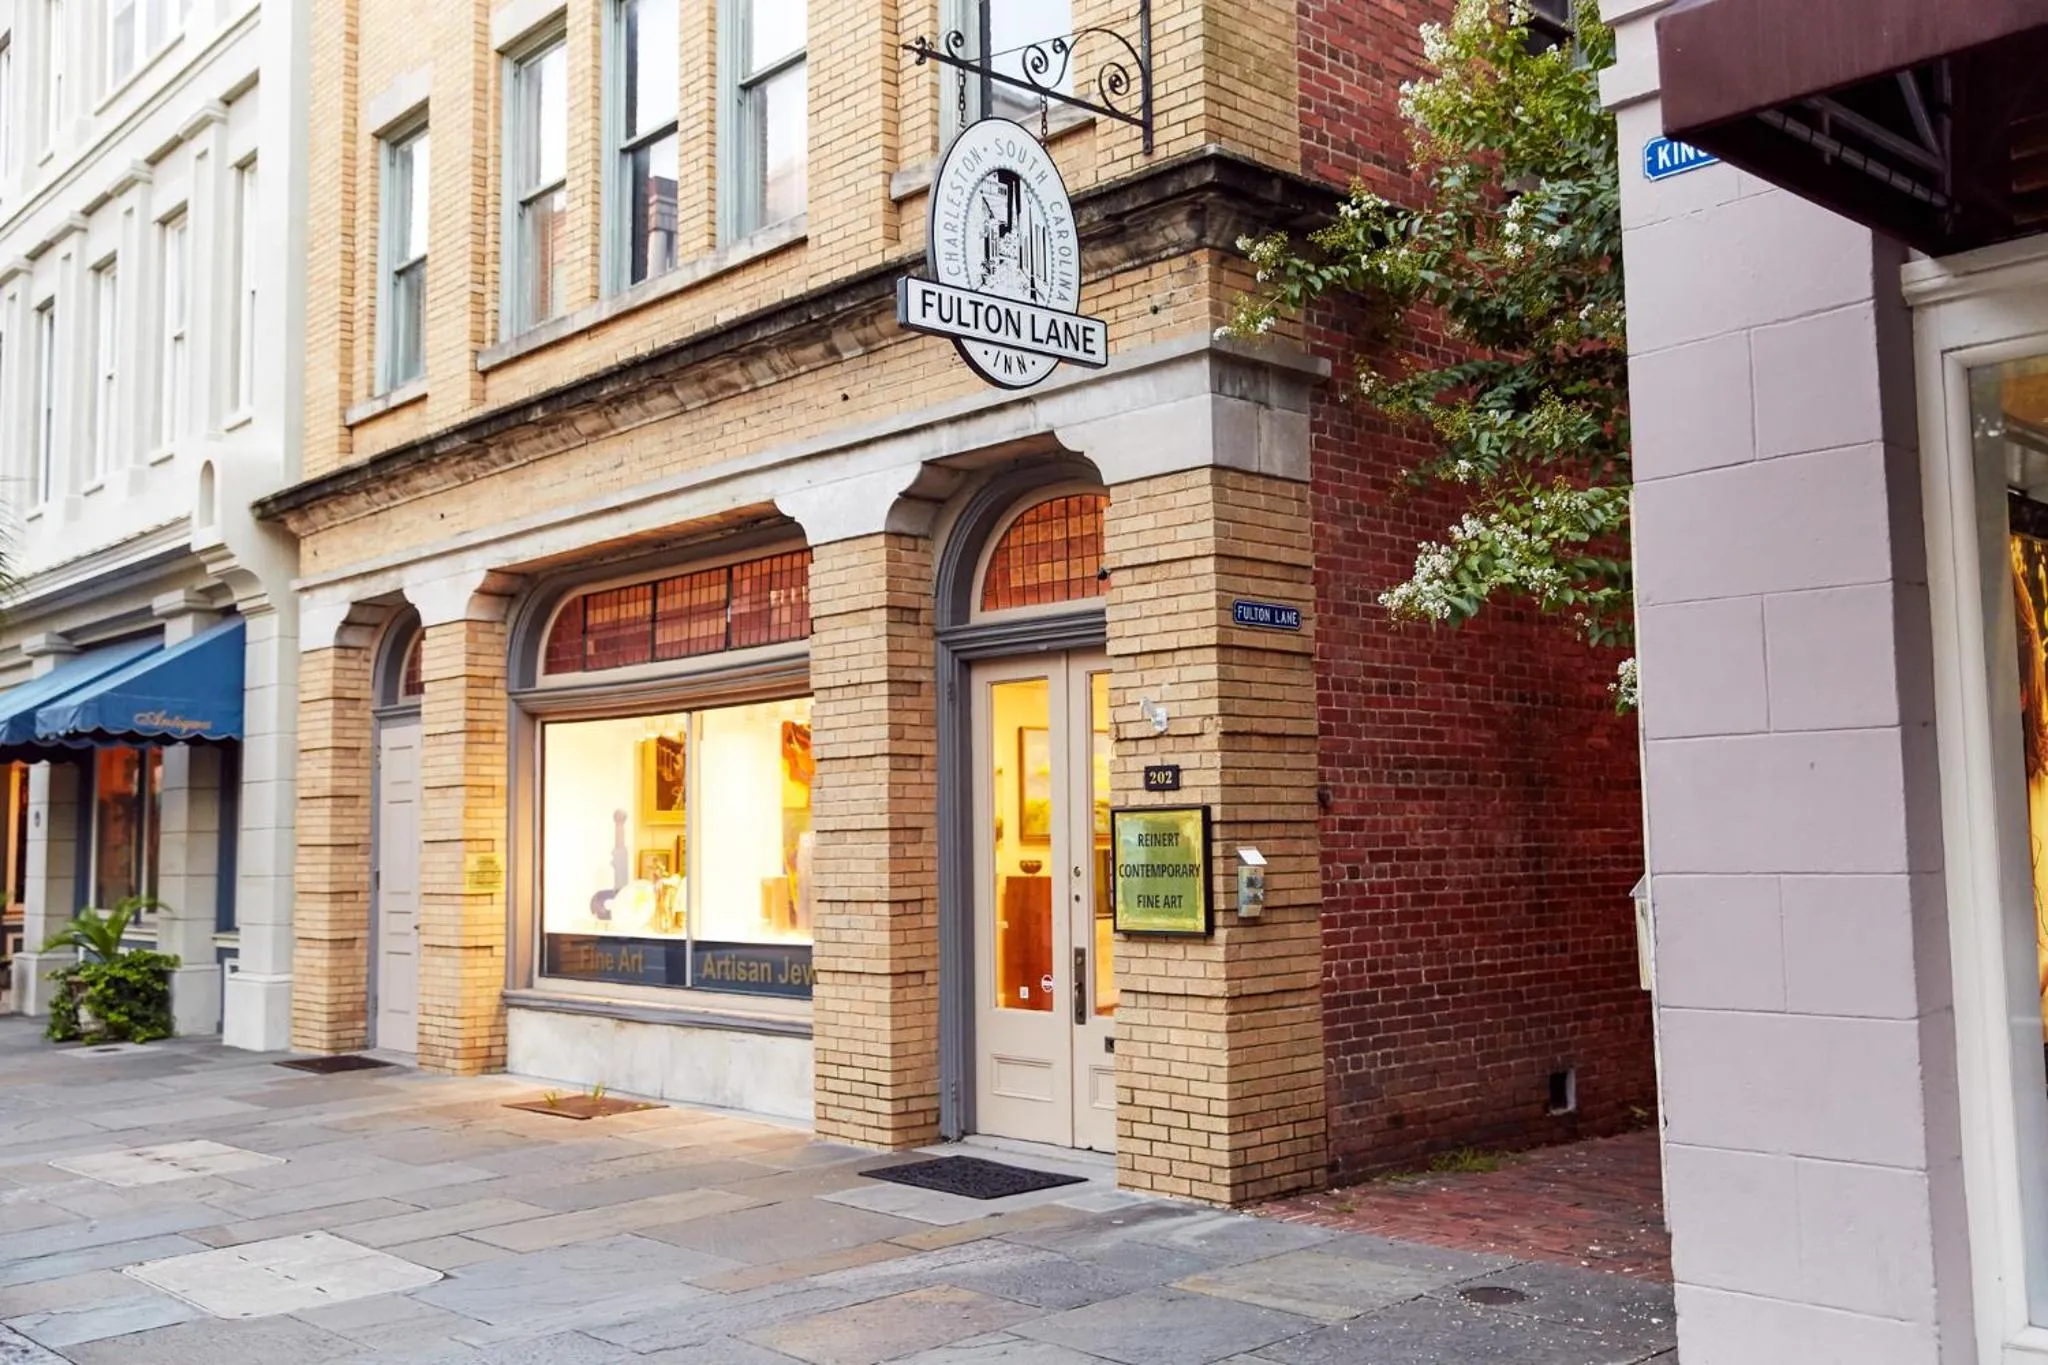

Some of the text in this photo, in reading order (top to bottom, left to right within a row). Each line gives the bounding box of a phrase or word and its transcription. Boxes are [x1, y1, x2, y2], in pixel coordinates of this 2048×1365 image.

[947, 138, 1073, 302] CHARLESTON SOUTH CAROLINA
[921, 289, 1097, 356] FULTON LANE
[993, 350, 1027, 375] INN
[1237, 605, 1298, 625] FULTON LANE
[1149, 770, 1173, 785] 202
[1137, 832, 1180, 848] REINERT
[1118, 863, 1201, 878] CONTEMPORARY
[1136, 894, 1184, 909] FINE ART
[580, 945, 644, 974] Fine Art
[701, 952, 772, 983] Artisan
